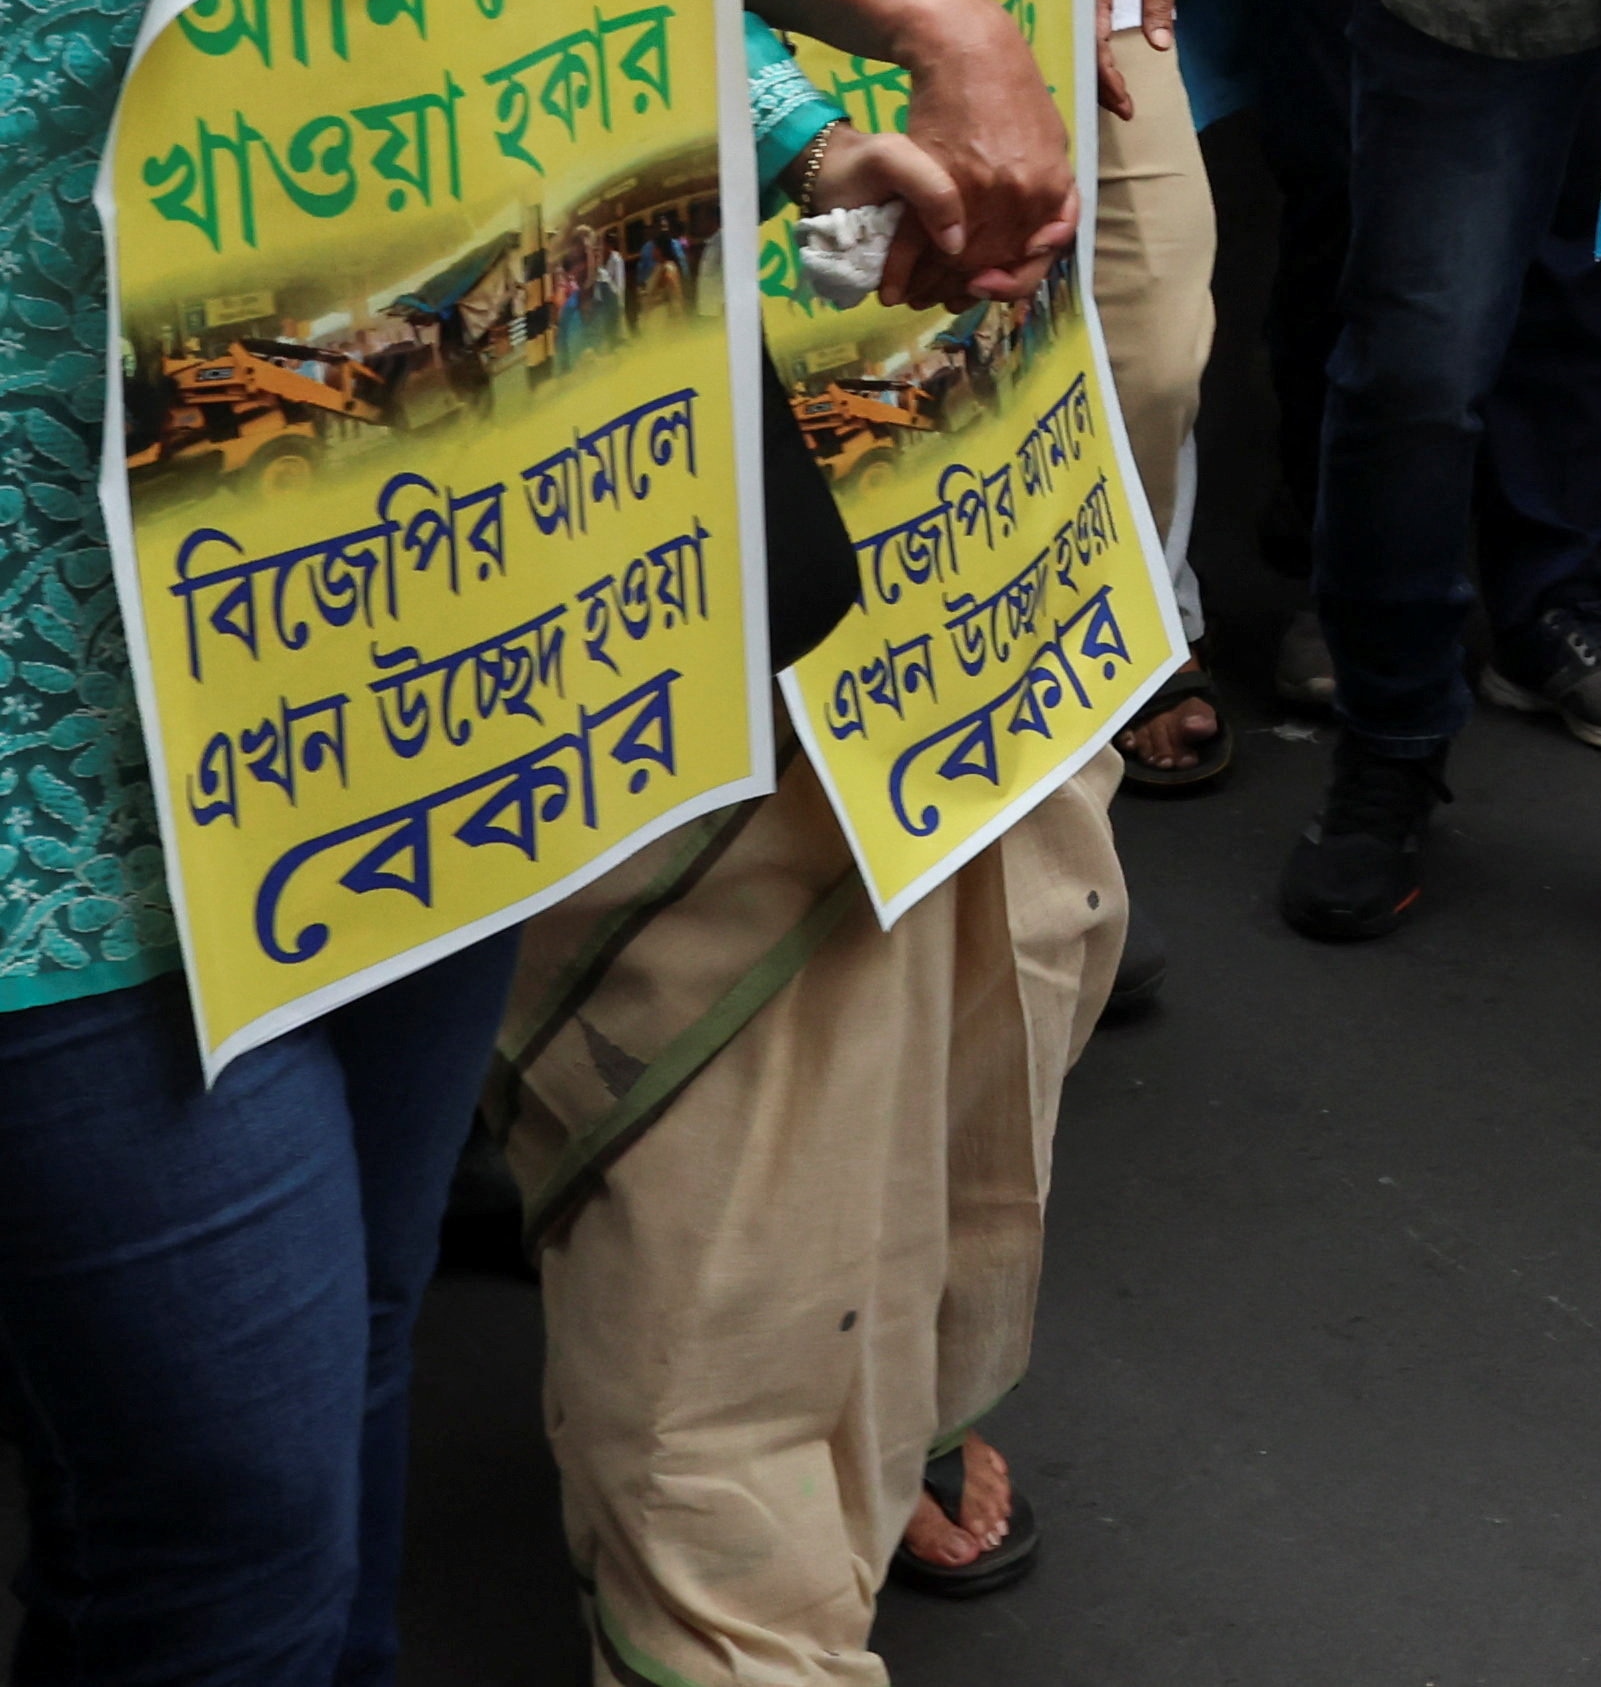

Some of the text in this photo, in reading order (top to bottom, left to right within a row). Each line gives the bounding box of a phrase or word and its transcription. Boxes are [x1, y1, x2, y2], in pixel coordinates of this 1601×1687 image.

[141, 69, 466, 253] খাওয়া
[482, 4, 677, 176] হকার
[169, 386, 701, 684] বিজেপির আমলে
[825, 466, 1119, 742] এখন উচ্ছেদ হওয়া
[853, 370, 1096, 616] জেপির আমলে
[186, 515, 711, 829] এখন উচ্ছেদ হওয়া
[888, 583, 1132, 837] বেকার
[253, 667, 685, 965] বেকার
